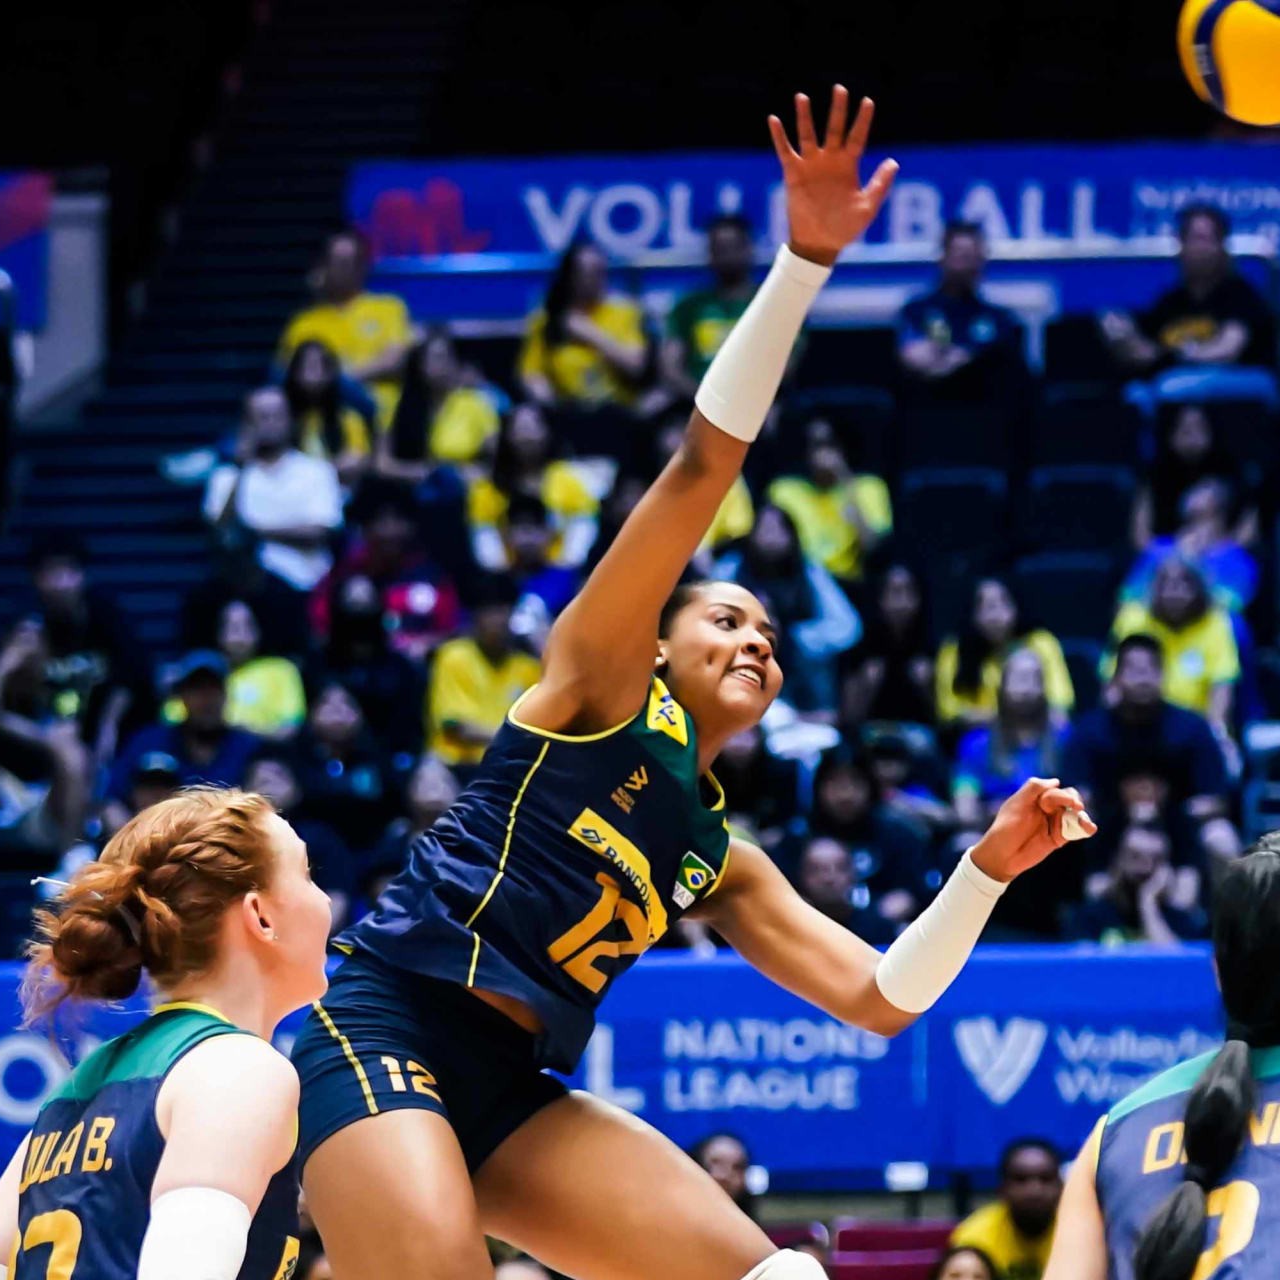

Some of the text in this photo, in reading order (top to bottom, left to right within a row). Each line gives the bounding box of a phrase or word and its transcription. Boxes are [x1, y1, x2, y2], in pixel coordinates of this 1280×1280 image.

[523, 182, 1114, 254] VOLBALL
[548, 872, 650, 994] 12
[664, 1018, 891, 1063] NATIONS
[381, 1055, 442, 1104] 12
[664, 1066, 859, 1112] LEAGUE
[81, 1116, 116, 1173] B.
